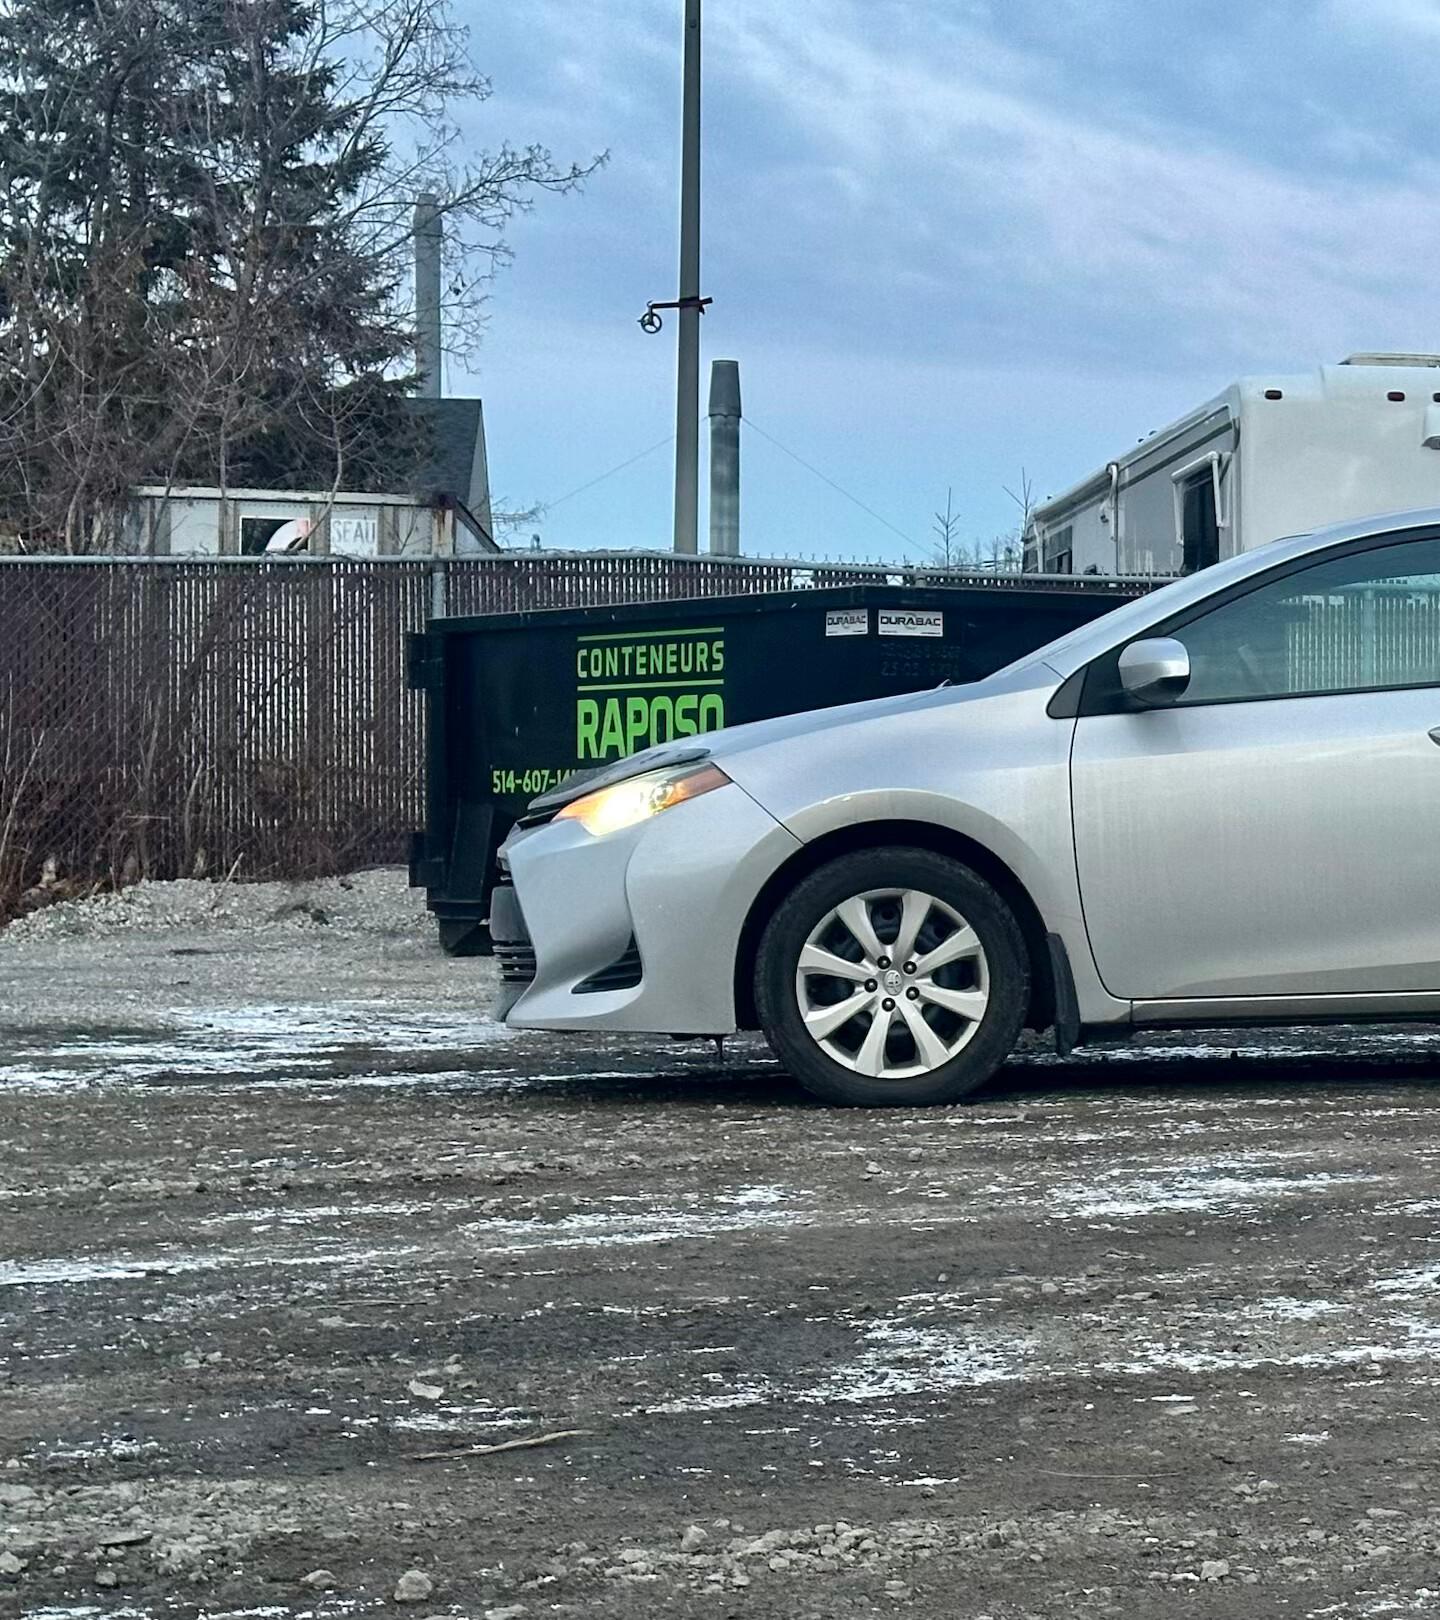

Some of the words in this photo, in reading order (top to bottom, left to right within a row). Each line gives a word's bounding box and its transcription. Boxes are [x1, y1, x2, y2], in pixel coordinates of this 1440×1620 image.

[827, 615, 866, 626] DURABAC
[880, 616, 941, 627] DURABAC
[577, 641, 725, 678] CONTENEURS
[577, 693, 725, 759] RAPOSO
